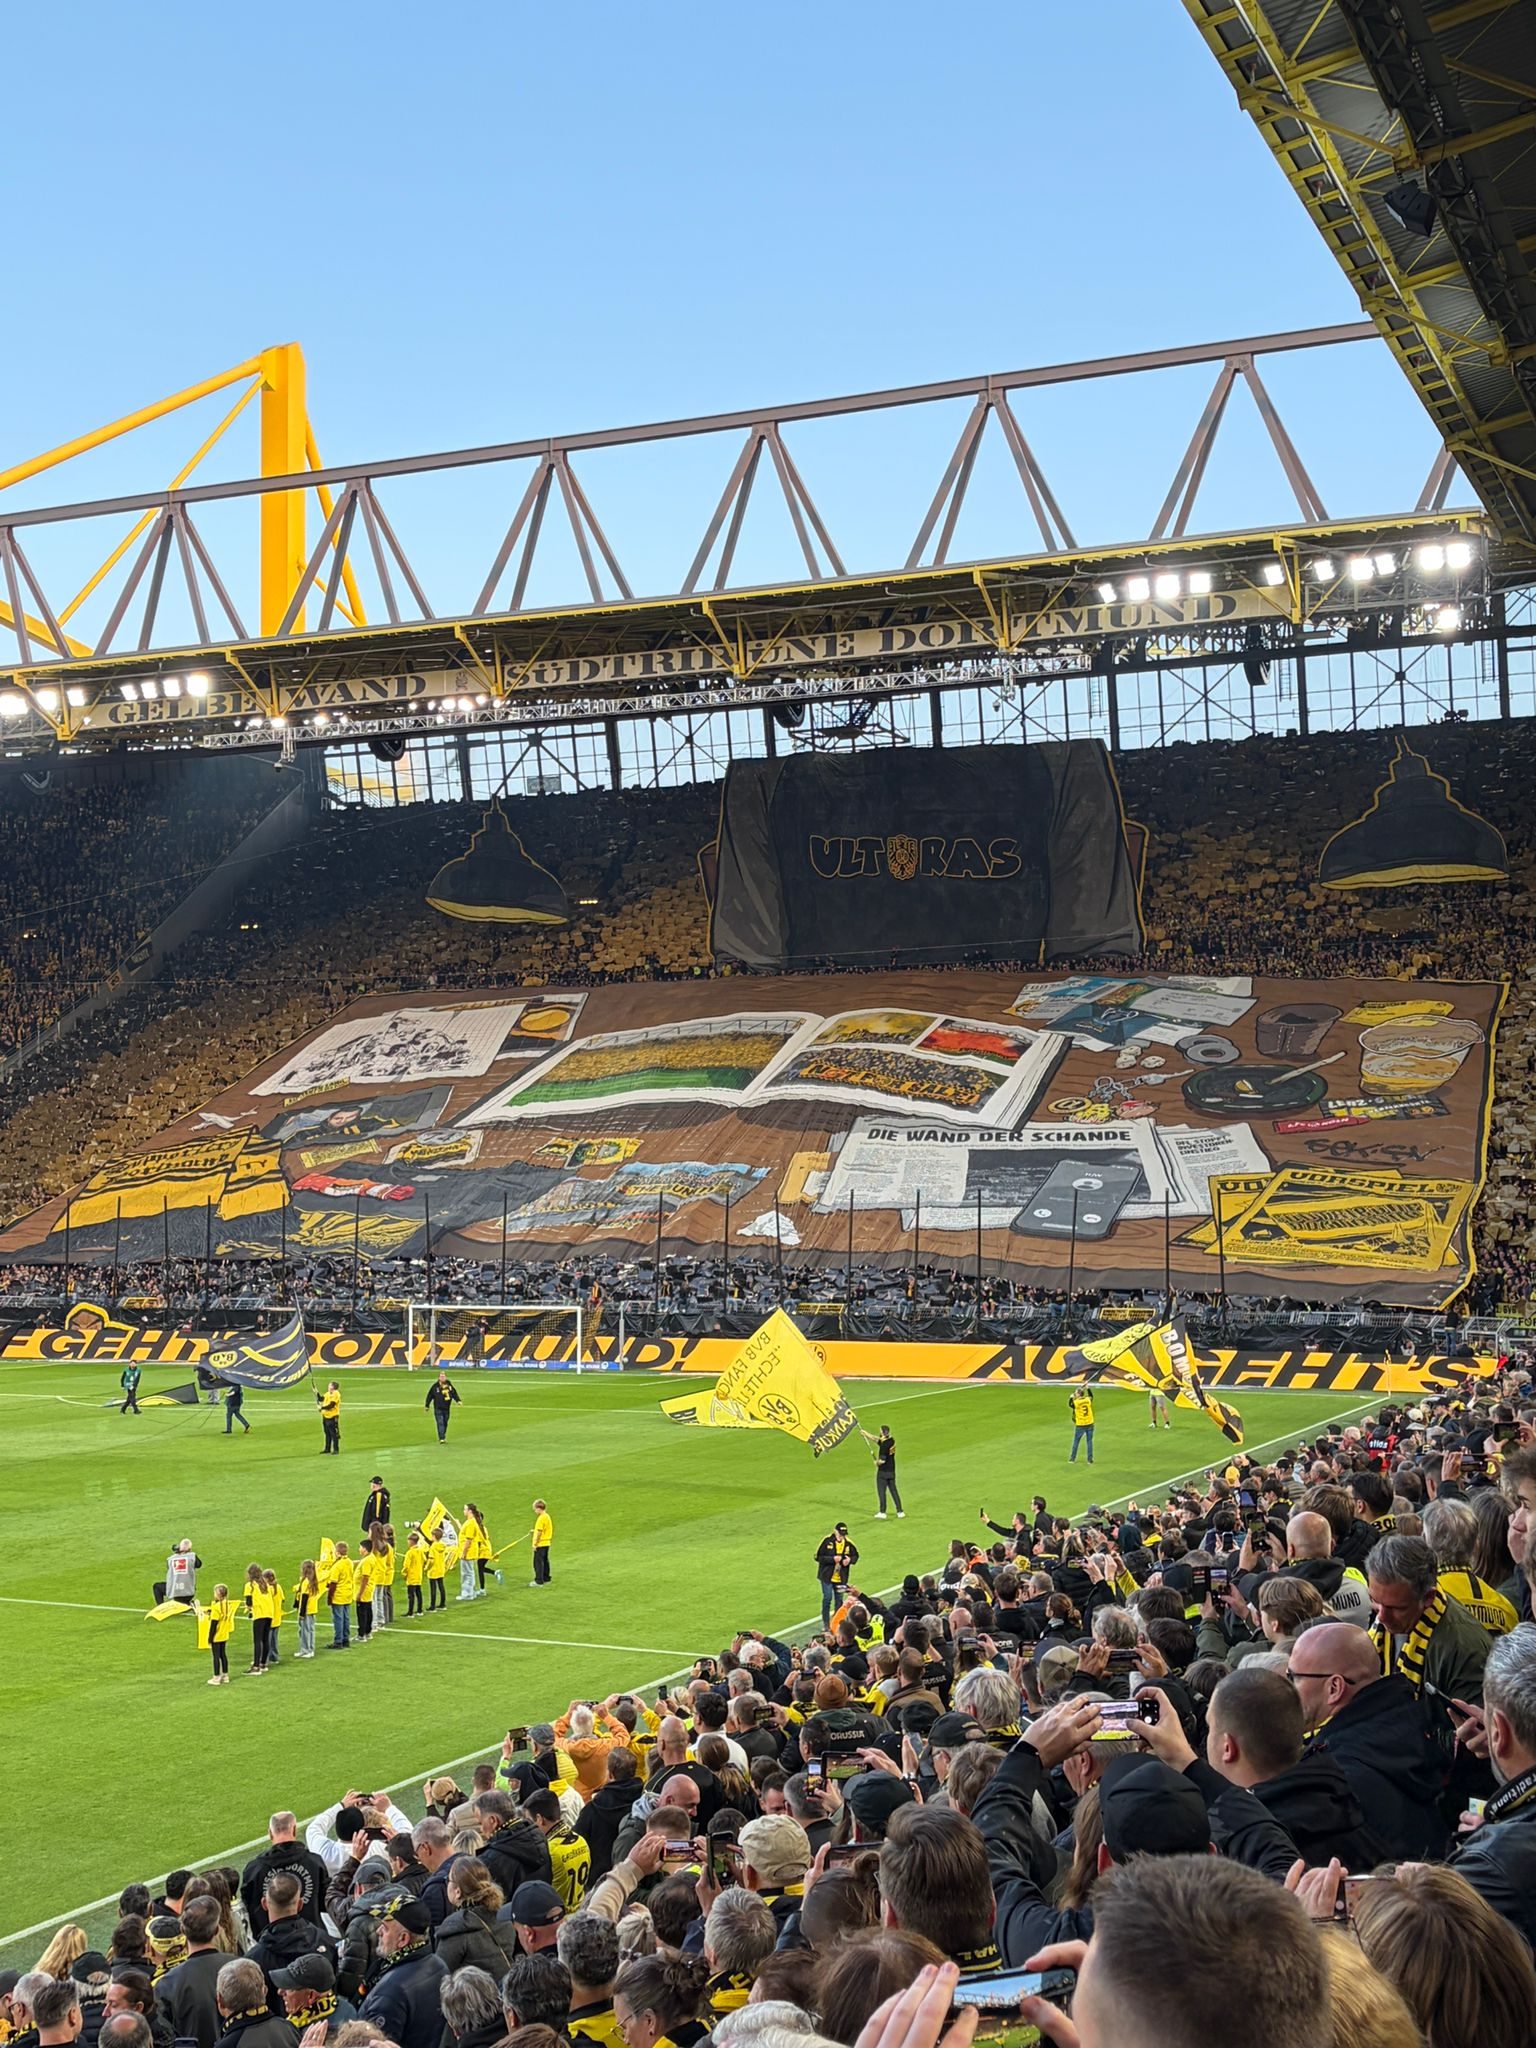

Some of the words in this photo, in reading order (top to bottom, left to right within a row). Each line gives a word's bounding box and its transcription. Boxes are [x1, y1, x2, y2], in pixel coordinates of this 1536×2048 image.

[108, 692, 257, 726] GELBE
[284, 674, 427, 707] WAND
[506, 632, 855, 688] SÜDTRIBÜNE
[878, 594, 1238, 653] DORTMUND
[867, 1128, 899, 1142] DIE
[906, 1129, 971, 1143] WAND
[979, 1130, 1024, 1143] DER
[1030, 1130, 1132, 1143] SCHANDE
[1218, 1180, 1268, 1192] VO
[1289, 1171, 1436, 1194] VORSPIEL
[1082, 1405, 1089, 1417] 3
